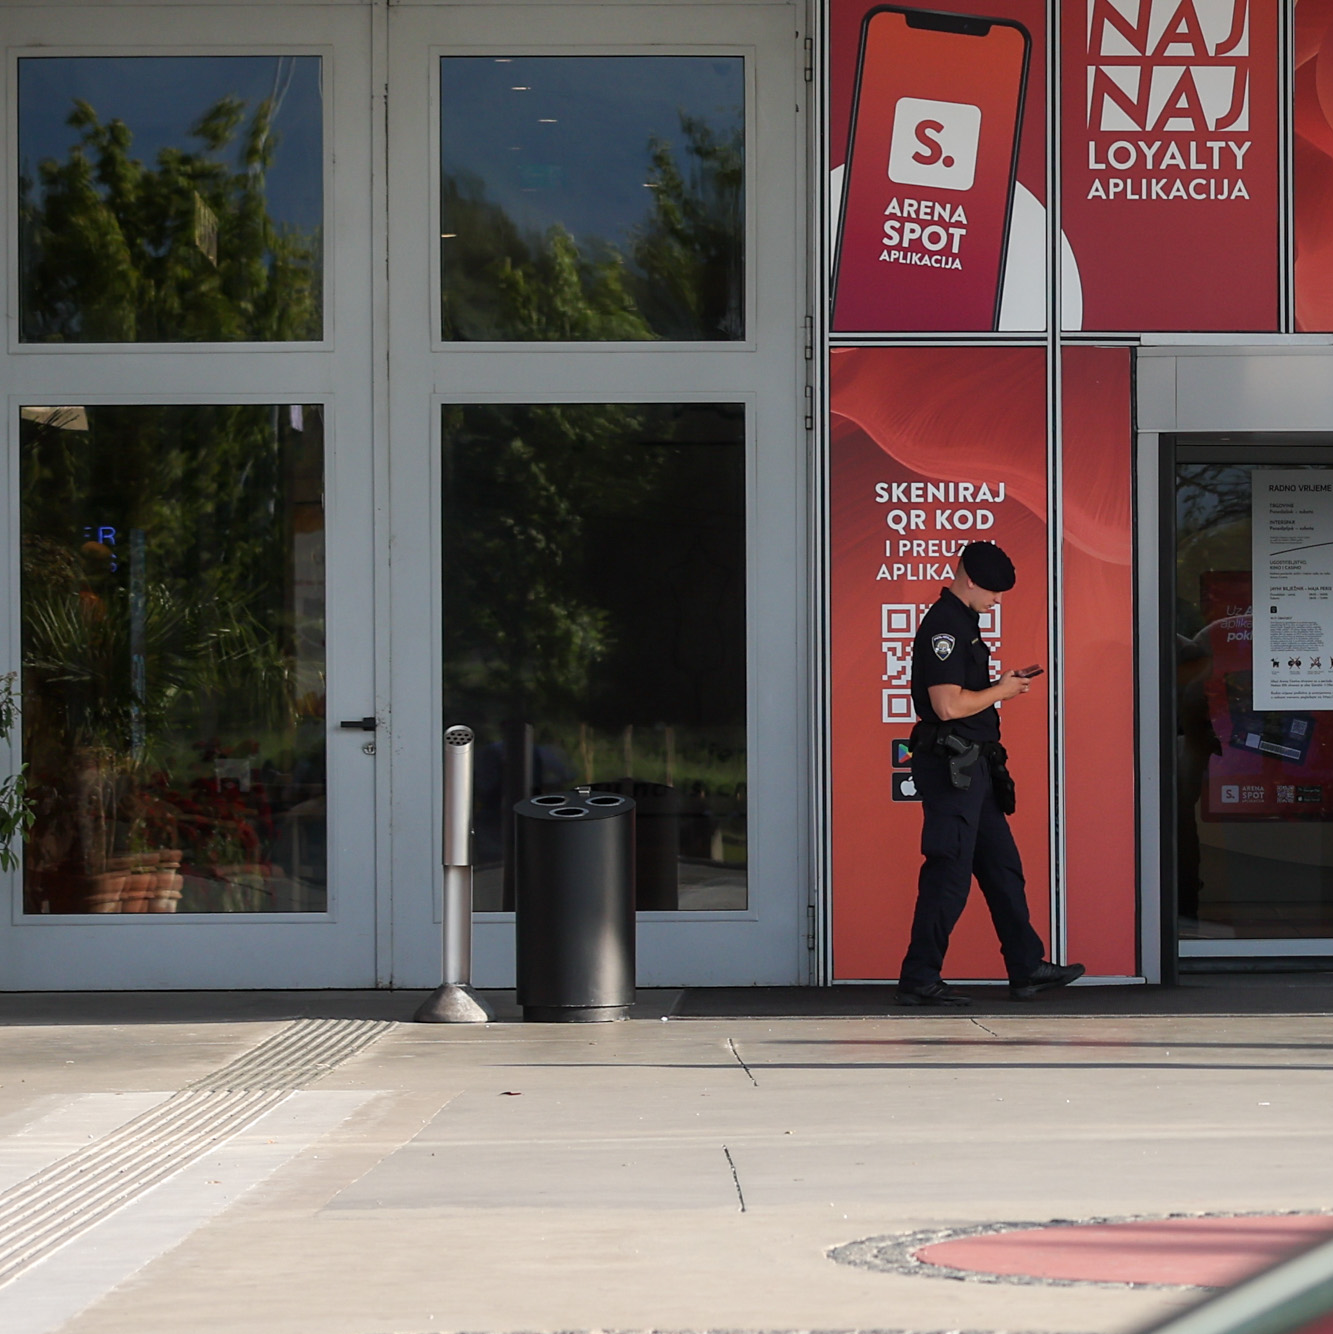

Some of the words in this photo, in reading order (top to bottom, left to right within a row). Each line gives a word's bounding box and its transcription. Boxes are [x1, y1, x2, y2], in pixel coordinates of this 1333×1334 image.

[1087, 0, 1249, 57] NAJ
[1087, 66, 1249, 131] NAJ
[912, 119, 955, 168] S.
[1089, 141, 1252, 170] LOYALTY
[1087, 178, 1250, 200] APLIKACIJA
[884, 197, 968, 225] ARENA
[882, 219, 967, 254] SPOT
[879, 249, 963, 270] APLIKACIJA
[875, 482, 1006, 503] SKENIRAJ
[1268, 484, 1297, 492] RADNO
[1298, 484, 1332, 492] VRIJEME
[886, 509, 926, 535] QR
[935, 509, 995, 530] KOD
[885, 540, 891, 557] I
[898, 540, 996, 557] PREUZ
[876, 563, 956, 581] APLIKA
